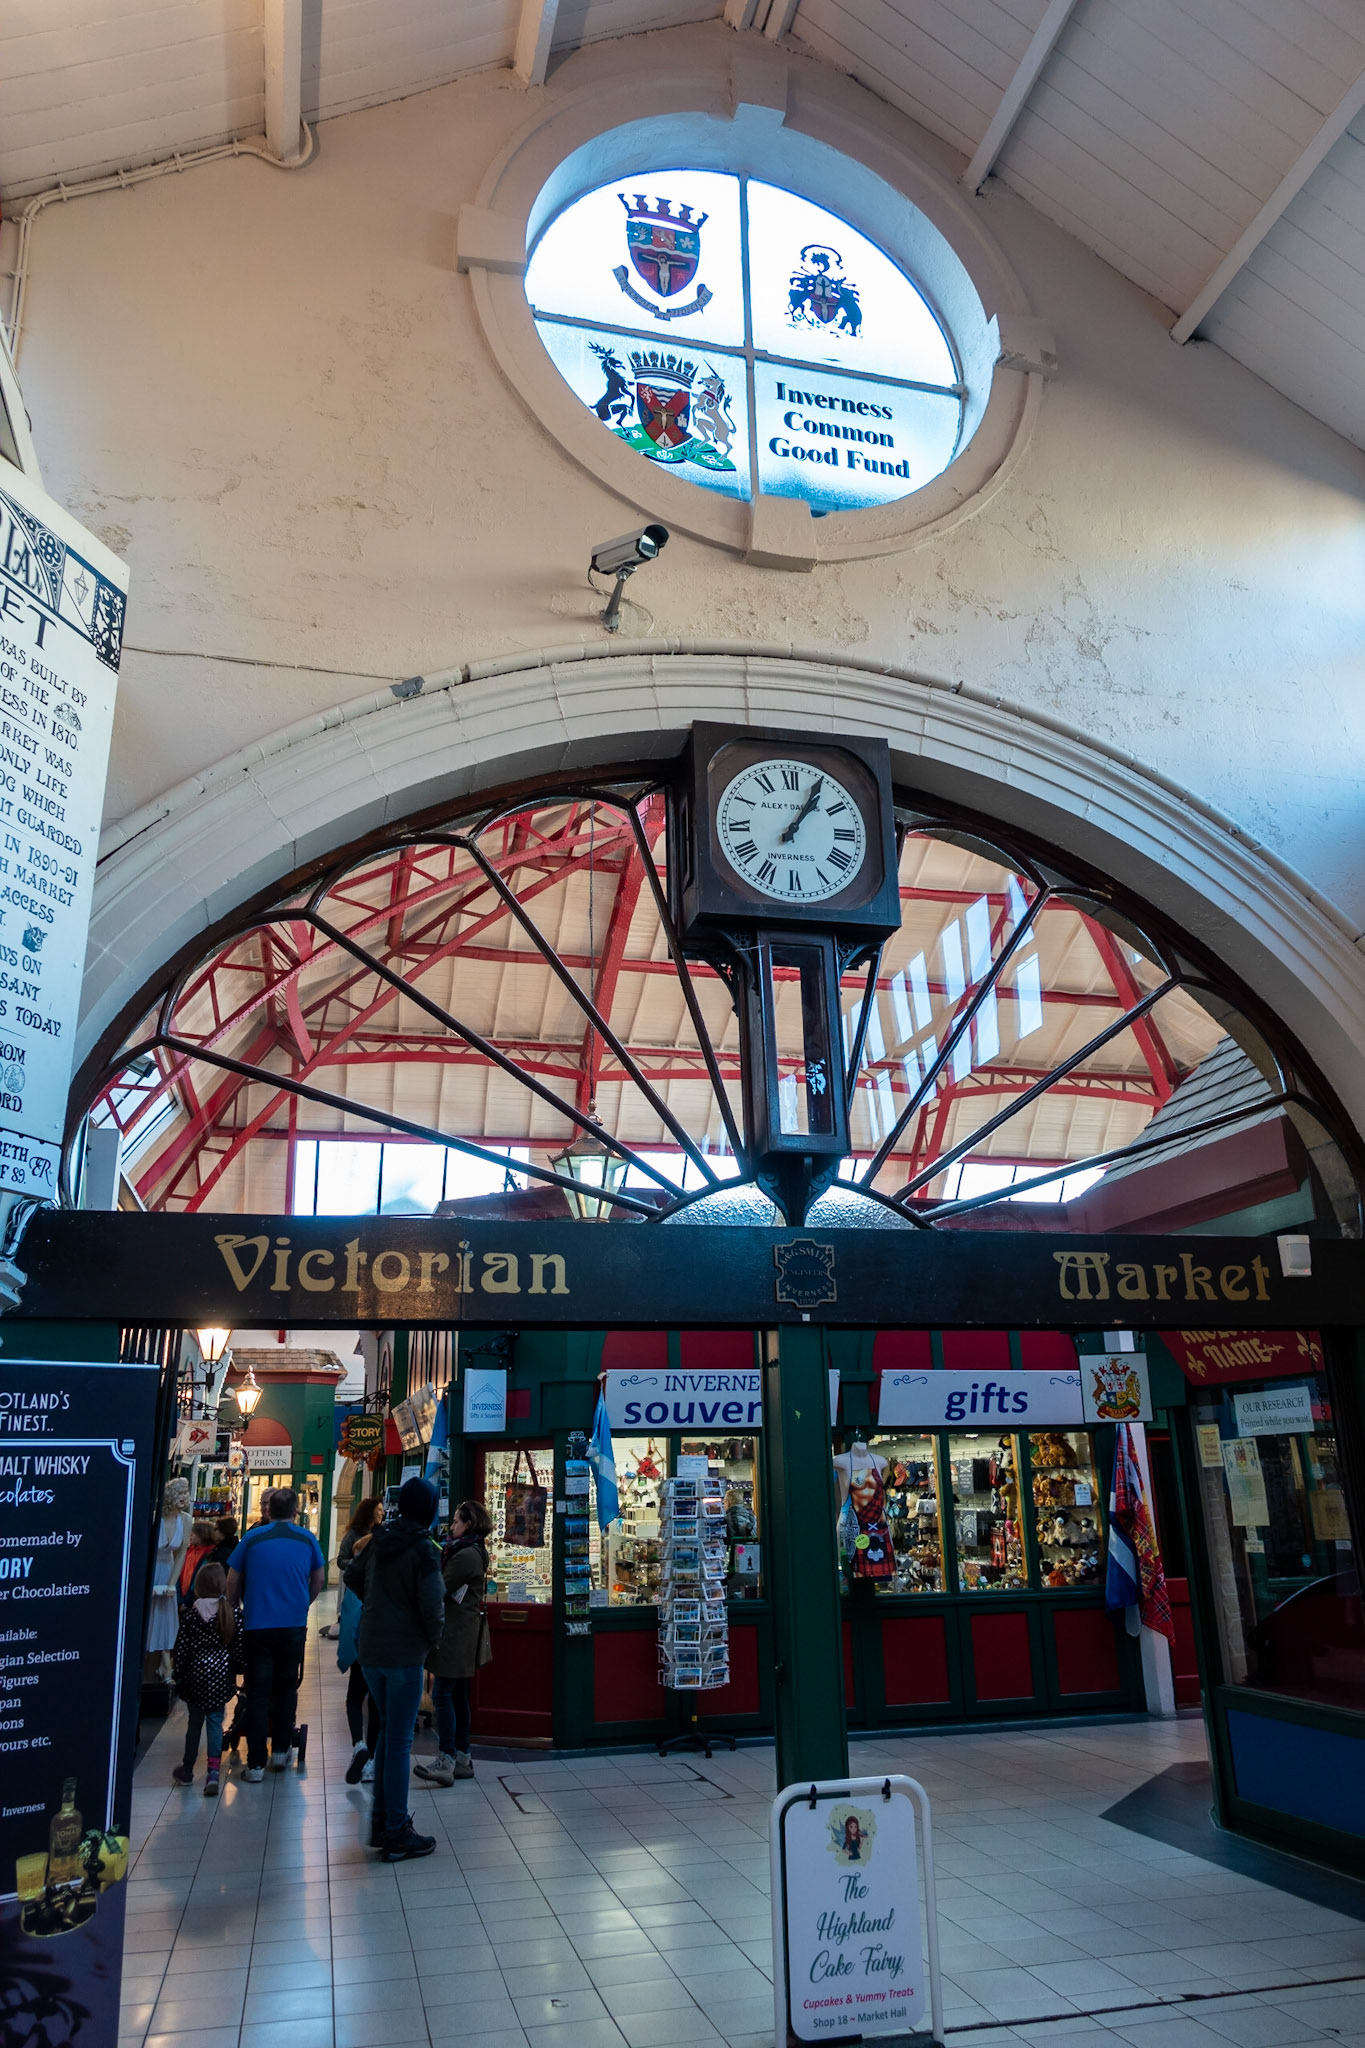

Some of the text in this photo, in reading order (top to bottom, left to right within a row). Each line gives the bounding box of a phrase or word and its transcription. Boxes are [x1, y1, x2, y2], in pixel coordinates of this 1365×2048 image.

[776, 382, 892, 420] Inverness
[784, 411, 894, 448] Common
[769, 437, 911, 480] Good Fund
[0, 508, 43, 596] IAN
[0, 582, 58, 651] ET
[1, 661, 49, 706] OF THE
[30, 658, 69, 696] BUILT
[71, 687, 88, 708] BY
[0, 685, 80, 751] ESS IN 1870.
[44, 747, 73, 778] WAS
[36, 768, 68, 799] LIFE
[23, 783, 65, 823] WHICH
[1, 796, 84, 858] IT GUARDED.
[5, 833, 79, 888] IN 1890-91
[768, 852, 815, 863] INVERNESS
[14, 864, 76, 908] MARKET
[1, 885, 55, 924] ACCESS
[22, 954, 43, 977] ON
[0, 971, 42, 1002] SANT
[0, 1091, 23, 1114] RD.
[214, 1234, 1271, 1300] Victorian Market
[1202, 1337, 1272, 1368] NAME
[471, 1403, 502, 1411] INVERNESS
[945, 1382, 1028, 1421] gifts
[1242, 1397, 1304, 1413] OUR RESEARCH
[348, 1427, 381, 1438] STORY
[1240, 1416, 1264, 1428] Printed
[1264, 1415, 1282, 1427] while
[1283, 1416, 1295, 1427] you
[34, 1455, 91, 1476] WHISKY
[254, 1458, 287, 1467] PRINTS
[66, 1531, 83, 1548] by
[12, 1583, 90, 1599] Chocolatiers
[27, 1649, 80, 1665] Selection
[31, 1736, 52, 1748] etc.
[2, 1802, 46, 1817] Inverness
[839, 1872, 869, 1903] The
[816, 1908, 895, 1946] Highland
[810, 1943, 905, 1984] Cake Fairy
[803, 1987, 914, 2010] Cupcakes & Yummy Treats
[813, 2016, 836, 2029] Shop
[838, 2014, 848, 2025] 18
[857, 2010, 889, 2023] Market
[891, 2006, 907, 2019] Hall
